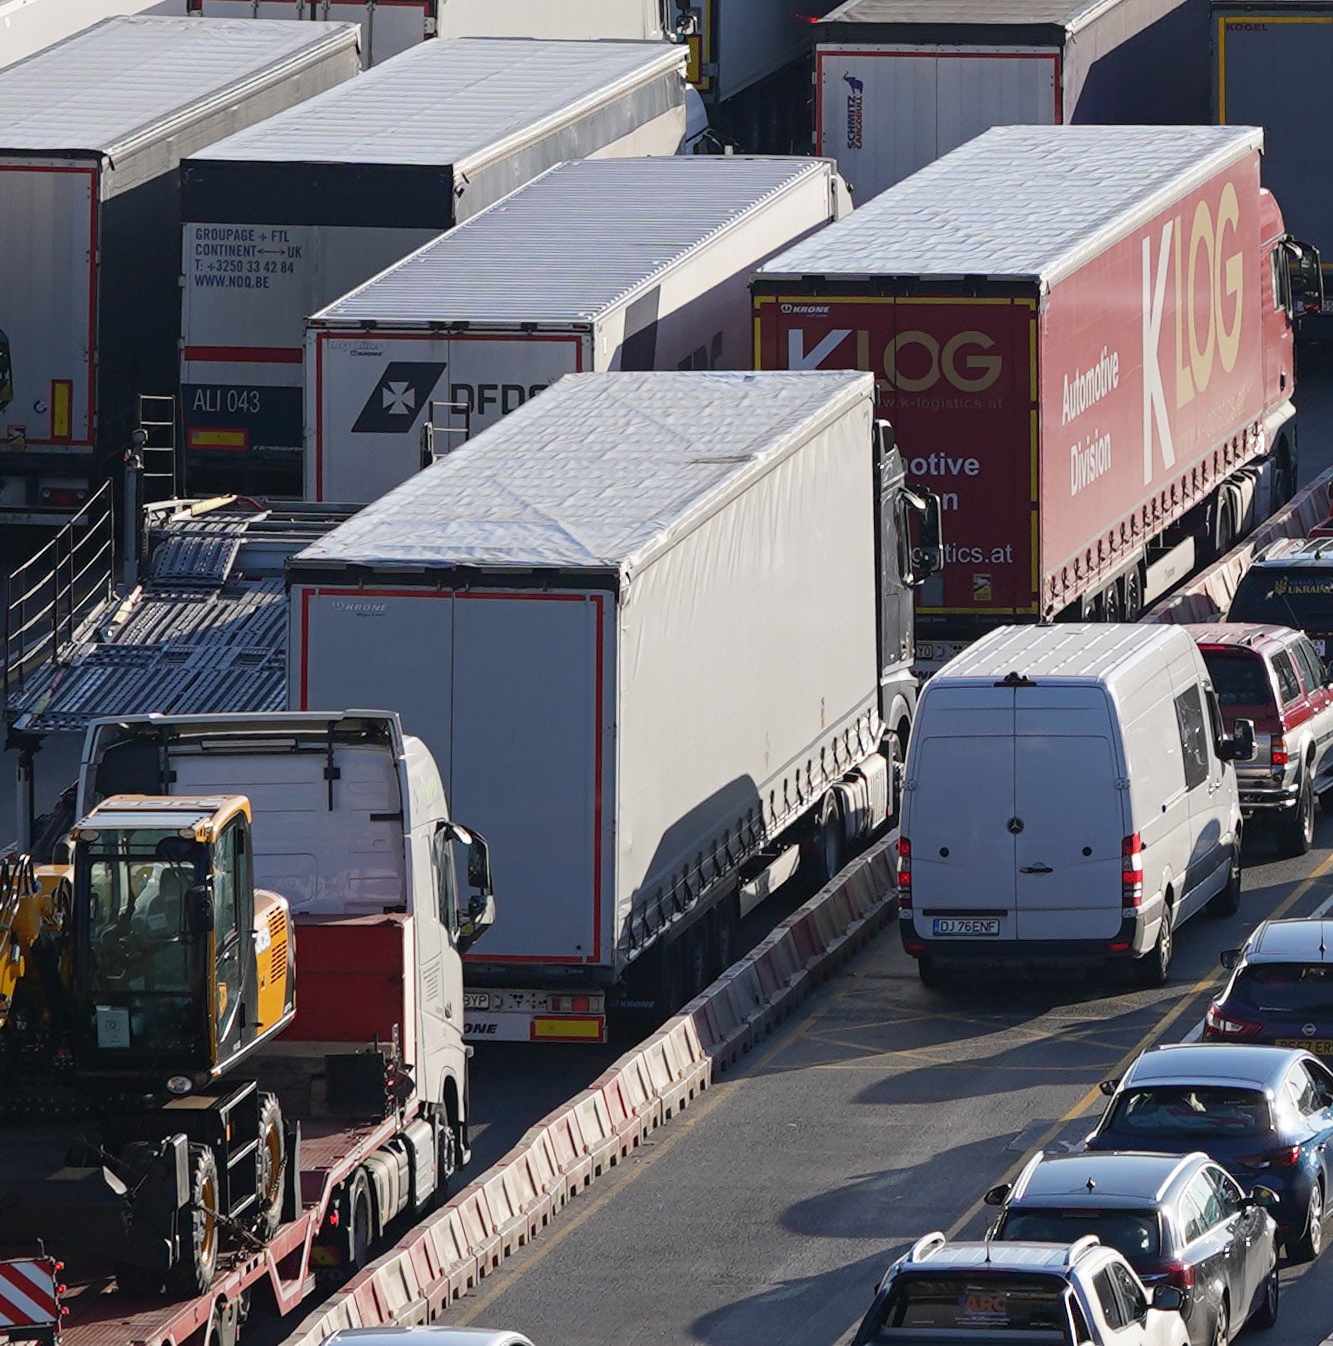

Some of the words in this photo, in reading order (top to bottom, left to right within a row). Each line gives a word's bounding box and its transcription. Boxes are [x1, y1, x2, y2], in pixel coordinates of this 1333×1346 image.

[847, 95, 855, 150] SCHMITZ
[855, 94, 863, 150] CARGOBULL
[195, 228, 254, 242] GROUPAGE
[259, 233, 266, 242] +
[271, 230, 290, 242] FTL
[195, 243, 257, 257] CONTINENT
[287, 246, 302, 259] UK
[195, 259, 206, 272] T:
[207, 259, 244, 273] +3250
[247, 260, 260, 273] 33
[262, 260, 279, 274] 42
[280, 261, 294, 274] 84
[1060, 345, 1117, 426] Automotive
[192, 388, 220, 412] ALI
[227, 389, 260, 413] 043
[1068, 429, 1110, 496] Division
[940, 919, 957, 932] DJ
[965, 1295, 1007, 1312] ARC
